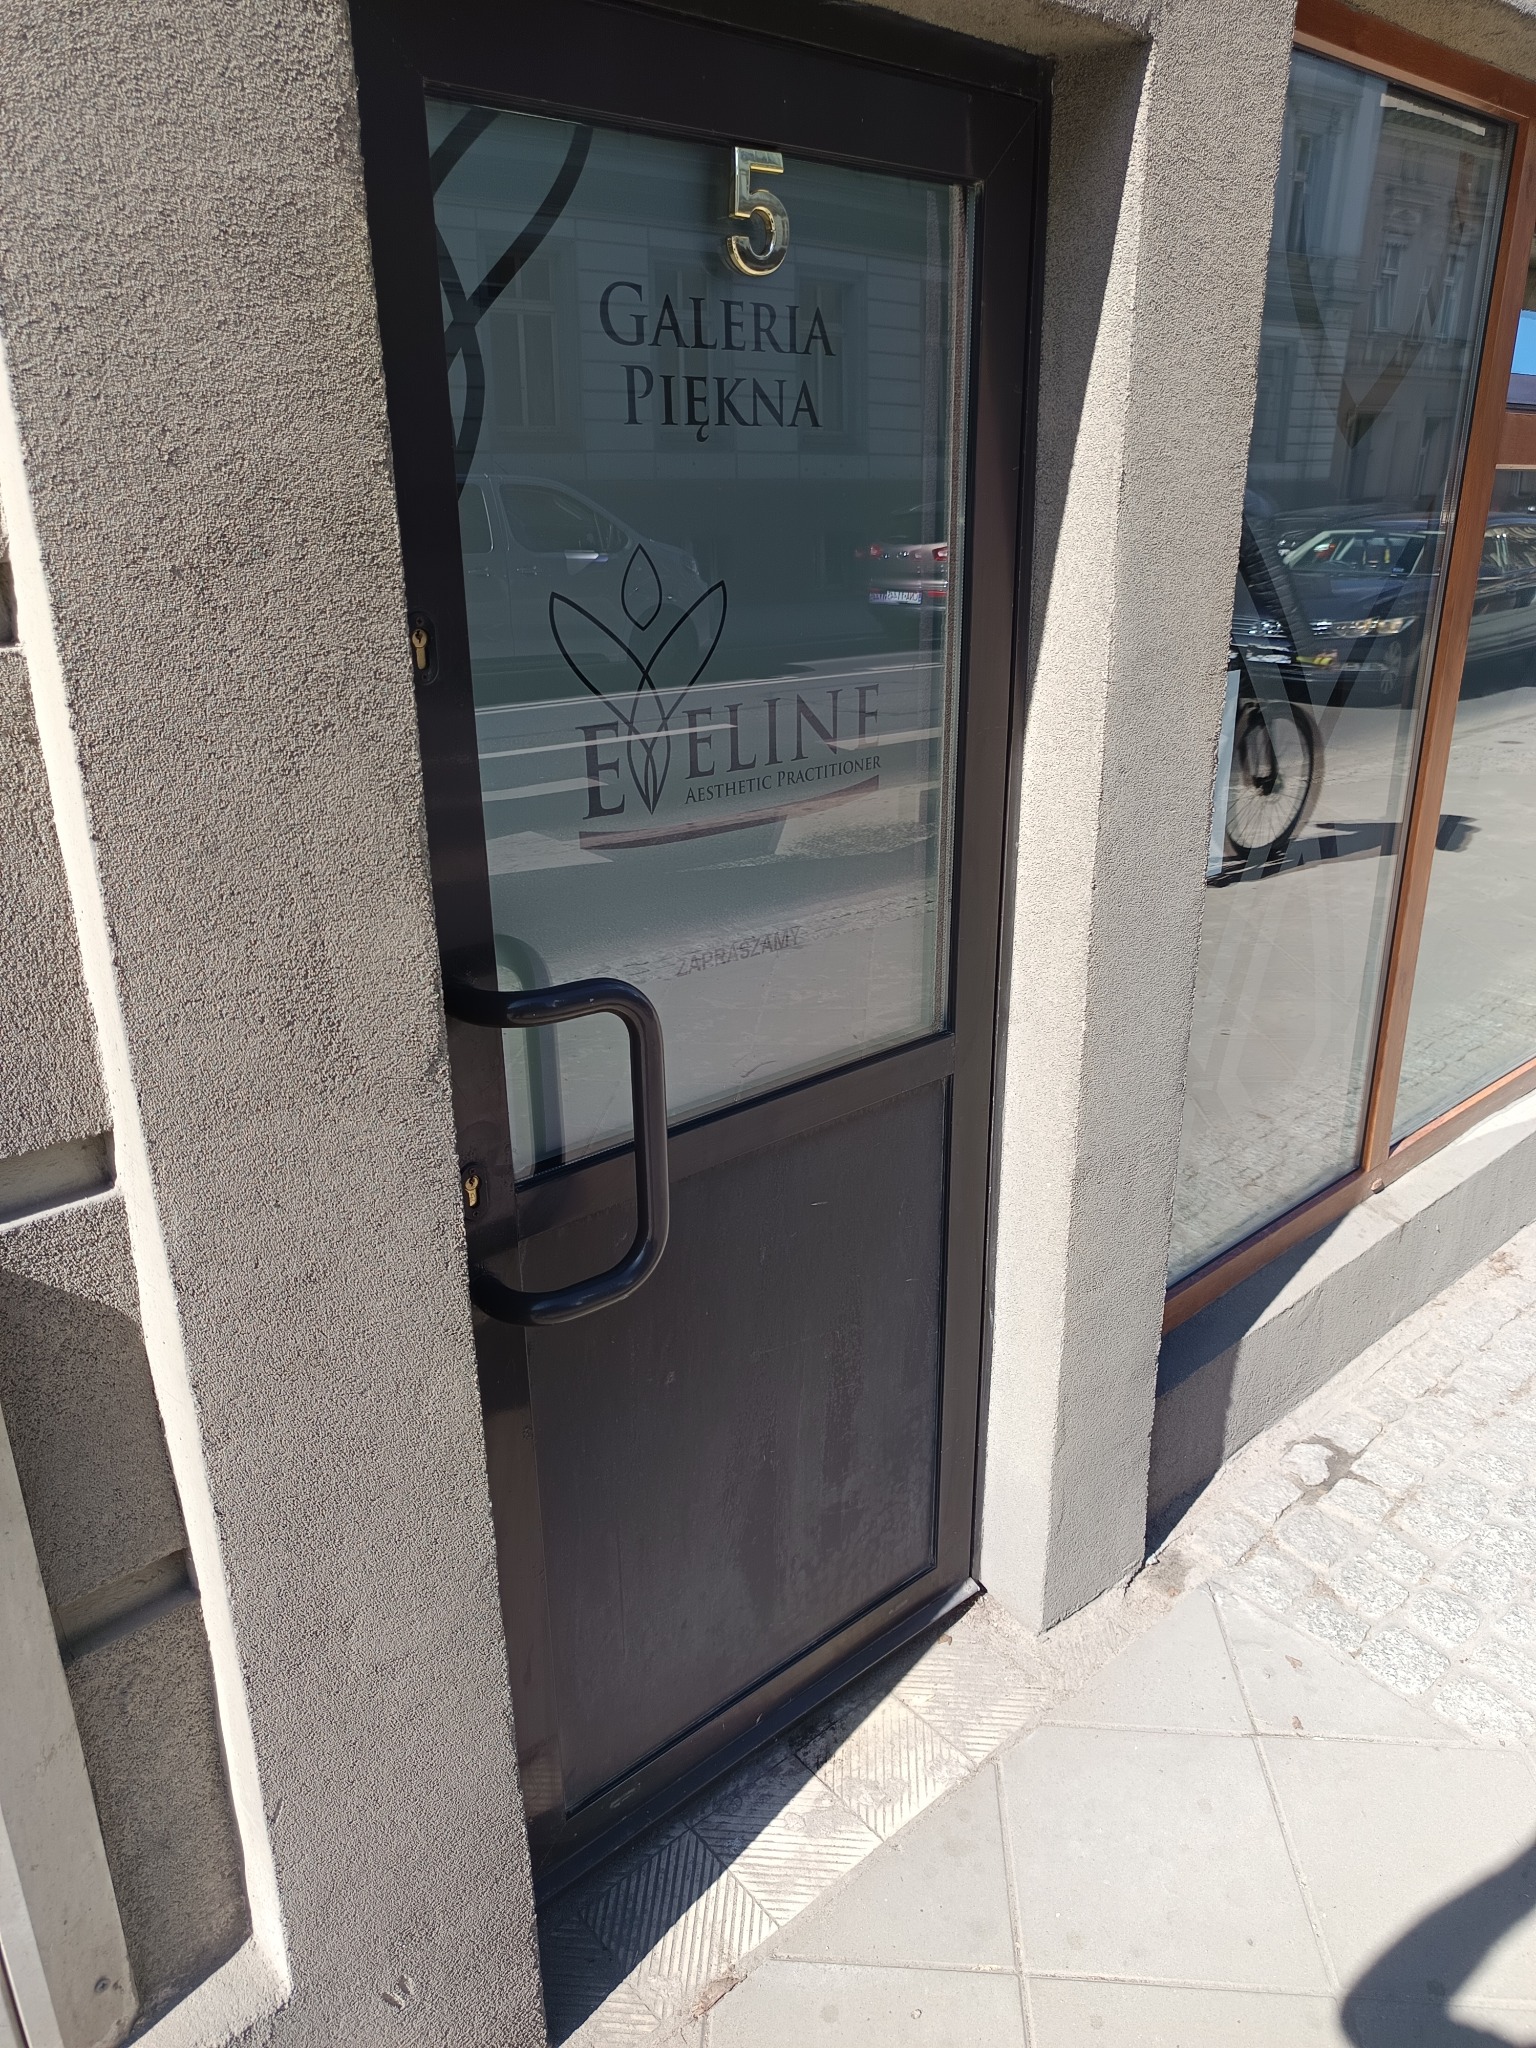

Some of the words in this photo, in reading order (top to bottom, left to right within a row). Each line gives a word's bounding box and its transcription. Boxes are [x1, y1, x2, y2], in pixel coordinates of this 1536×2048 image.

[726, 146, 790, 276] 5
[600, 281, 836, 357] GALERIA
[621, 364, 823, 442] PIĘKNA
[684, 775, 772, 804] AESTHETIC
[776, 755, 881, 788] PRACTITIONER
[676, 925, 802, 977] ZAPRASZAMY
